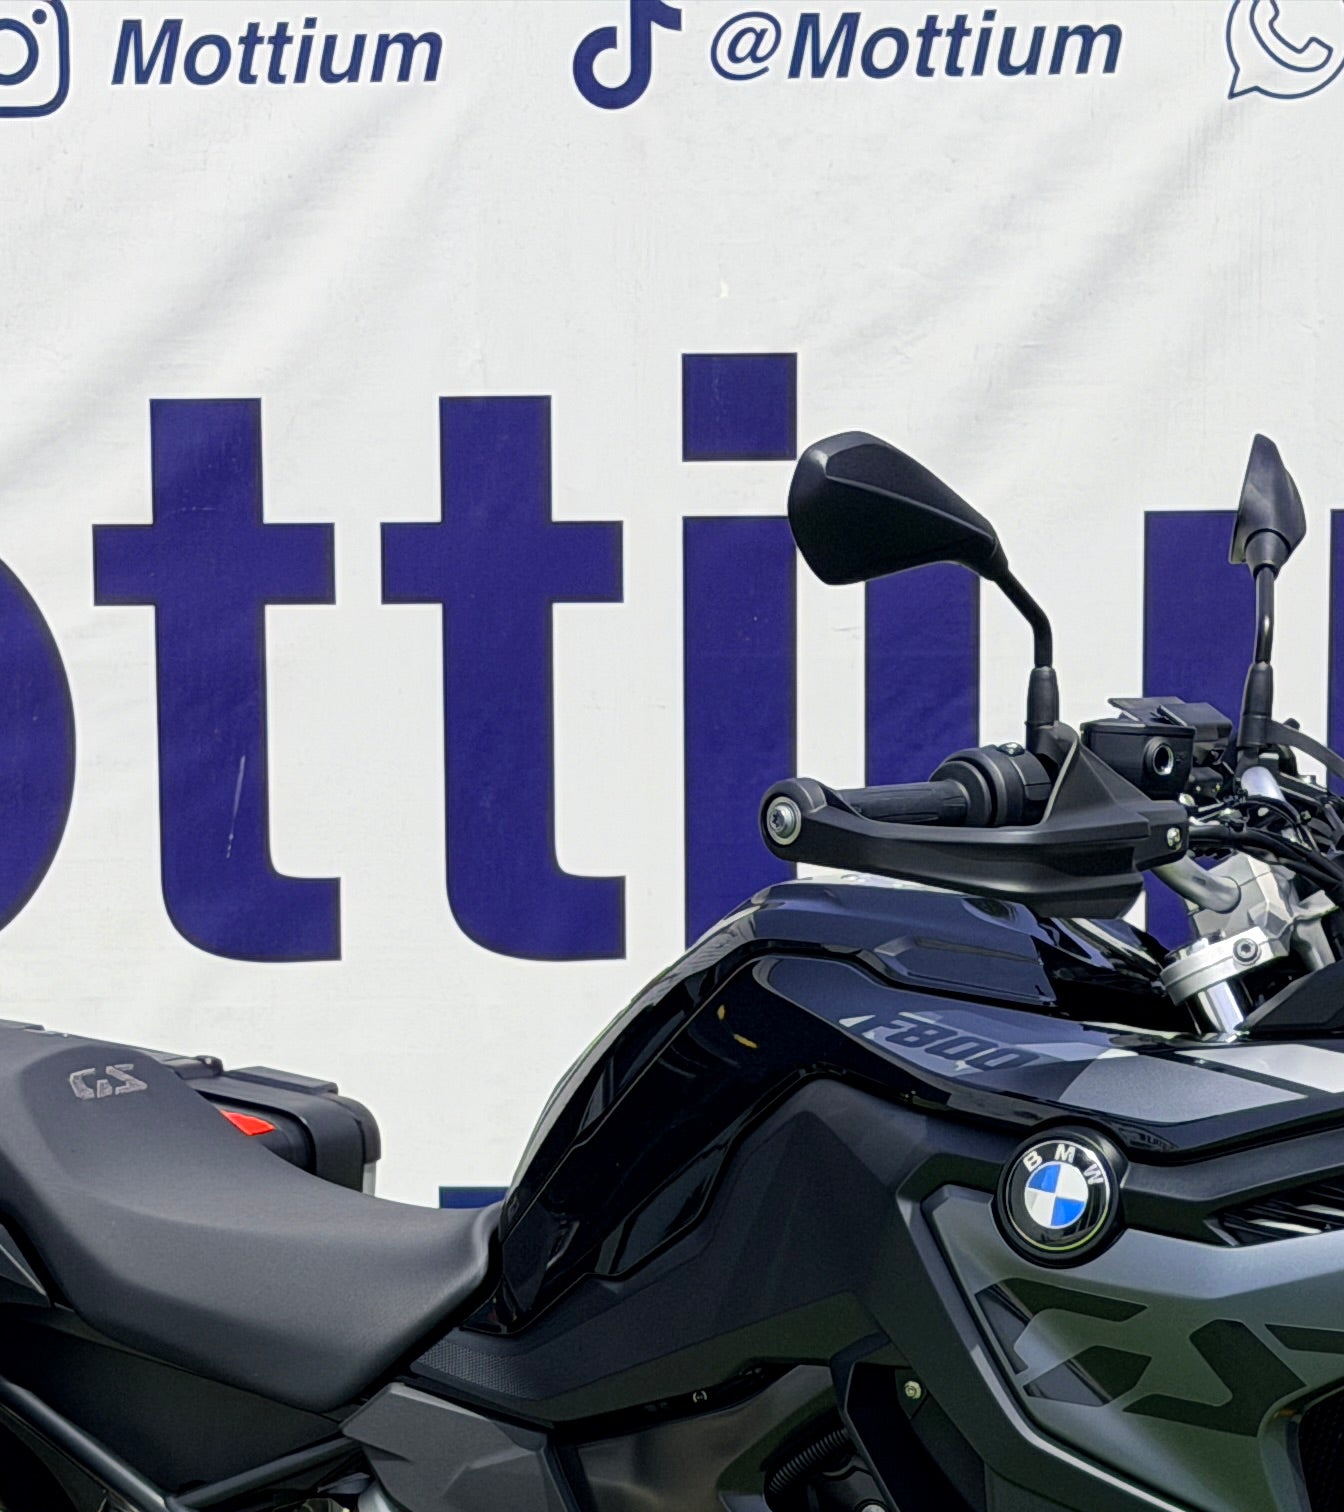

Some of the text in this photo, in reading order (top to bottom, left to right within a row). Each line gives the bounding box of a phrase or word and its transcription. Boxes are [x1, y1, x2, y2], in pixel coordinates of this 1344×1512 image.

[111, 17, 443, 86] Mottium
[709, 10, 1122, 82] @Mottium
[69, 1063, 148, 1100] GS
[1022, 1143, 1104, 1185] BMW
